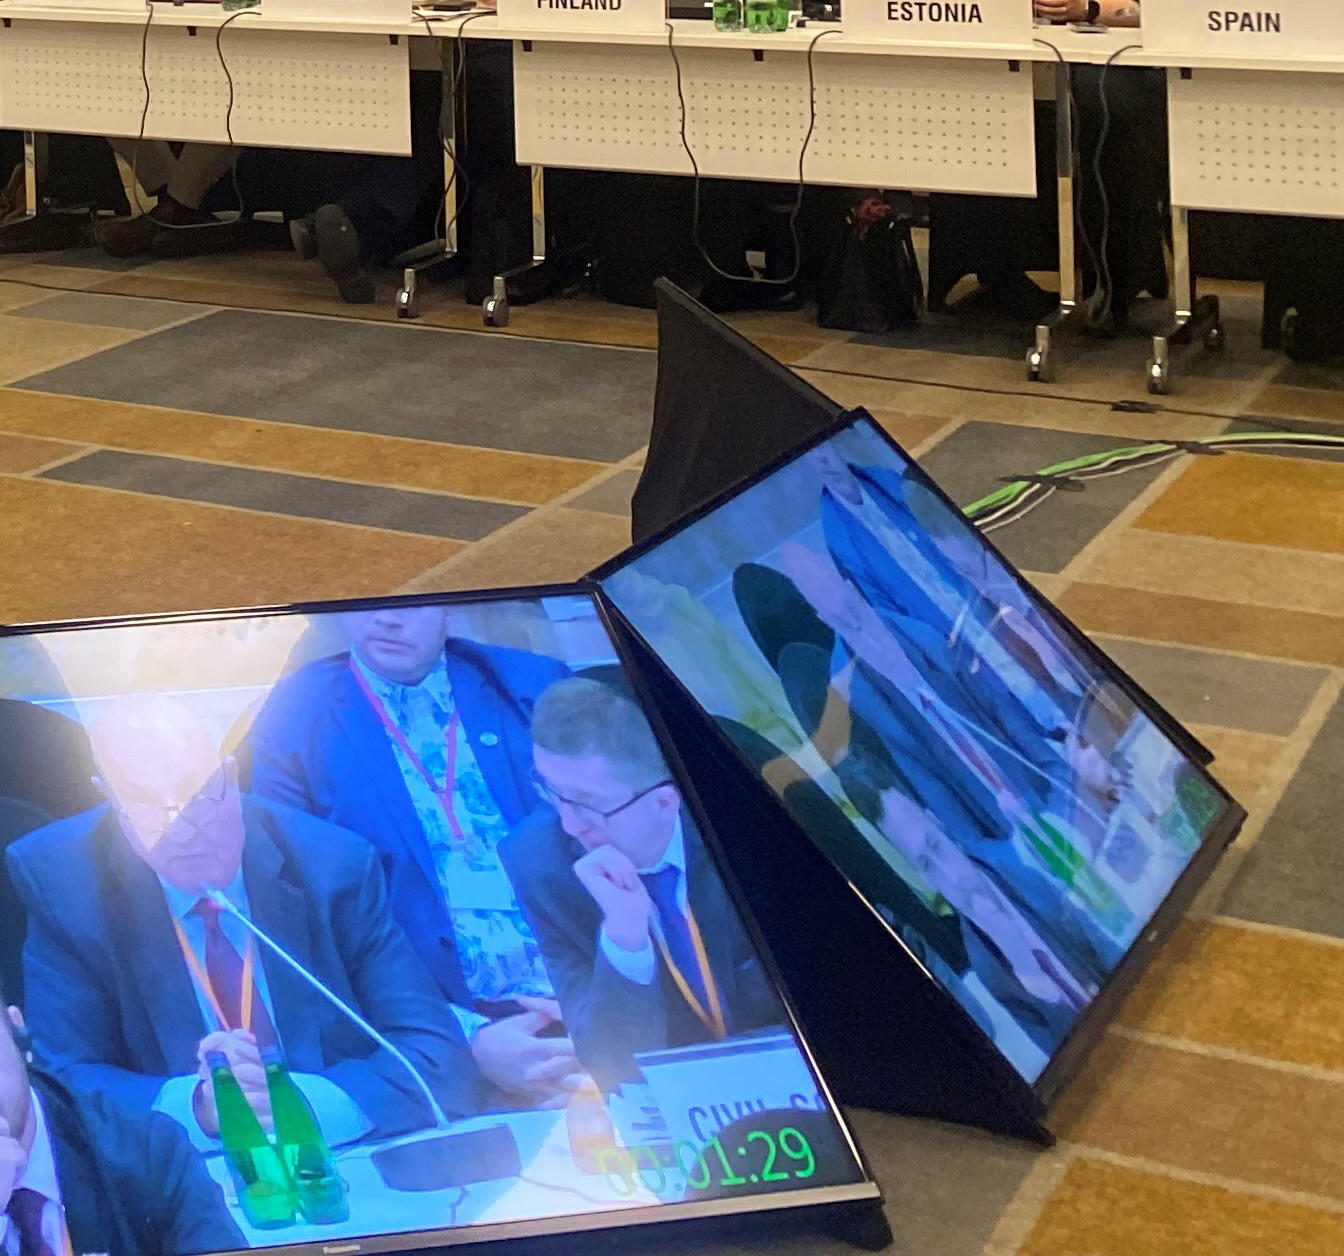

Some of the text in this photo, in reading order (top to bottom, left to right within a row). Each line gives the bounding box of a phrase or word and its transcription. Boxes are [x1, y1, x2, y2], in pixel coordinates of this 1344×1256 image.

[887, 1, 983, 24] ESTONIA
[1207, 10, 1281, 33] SPAIN
[598, 1127, 816, 1197] 00:01:29
